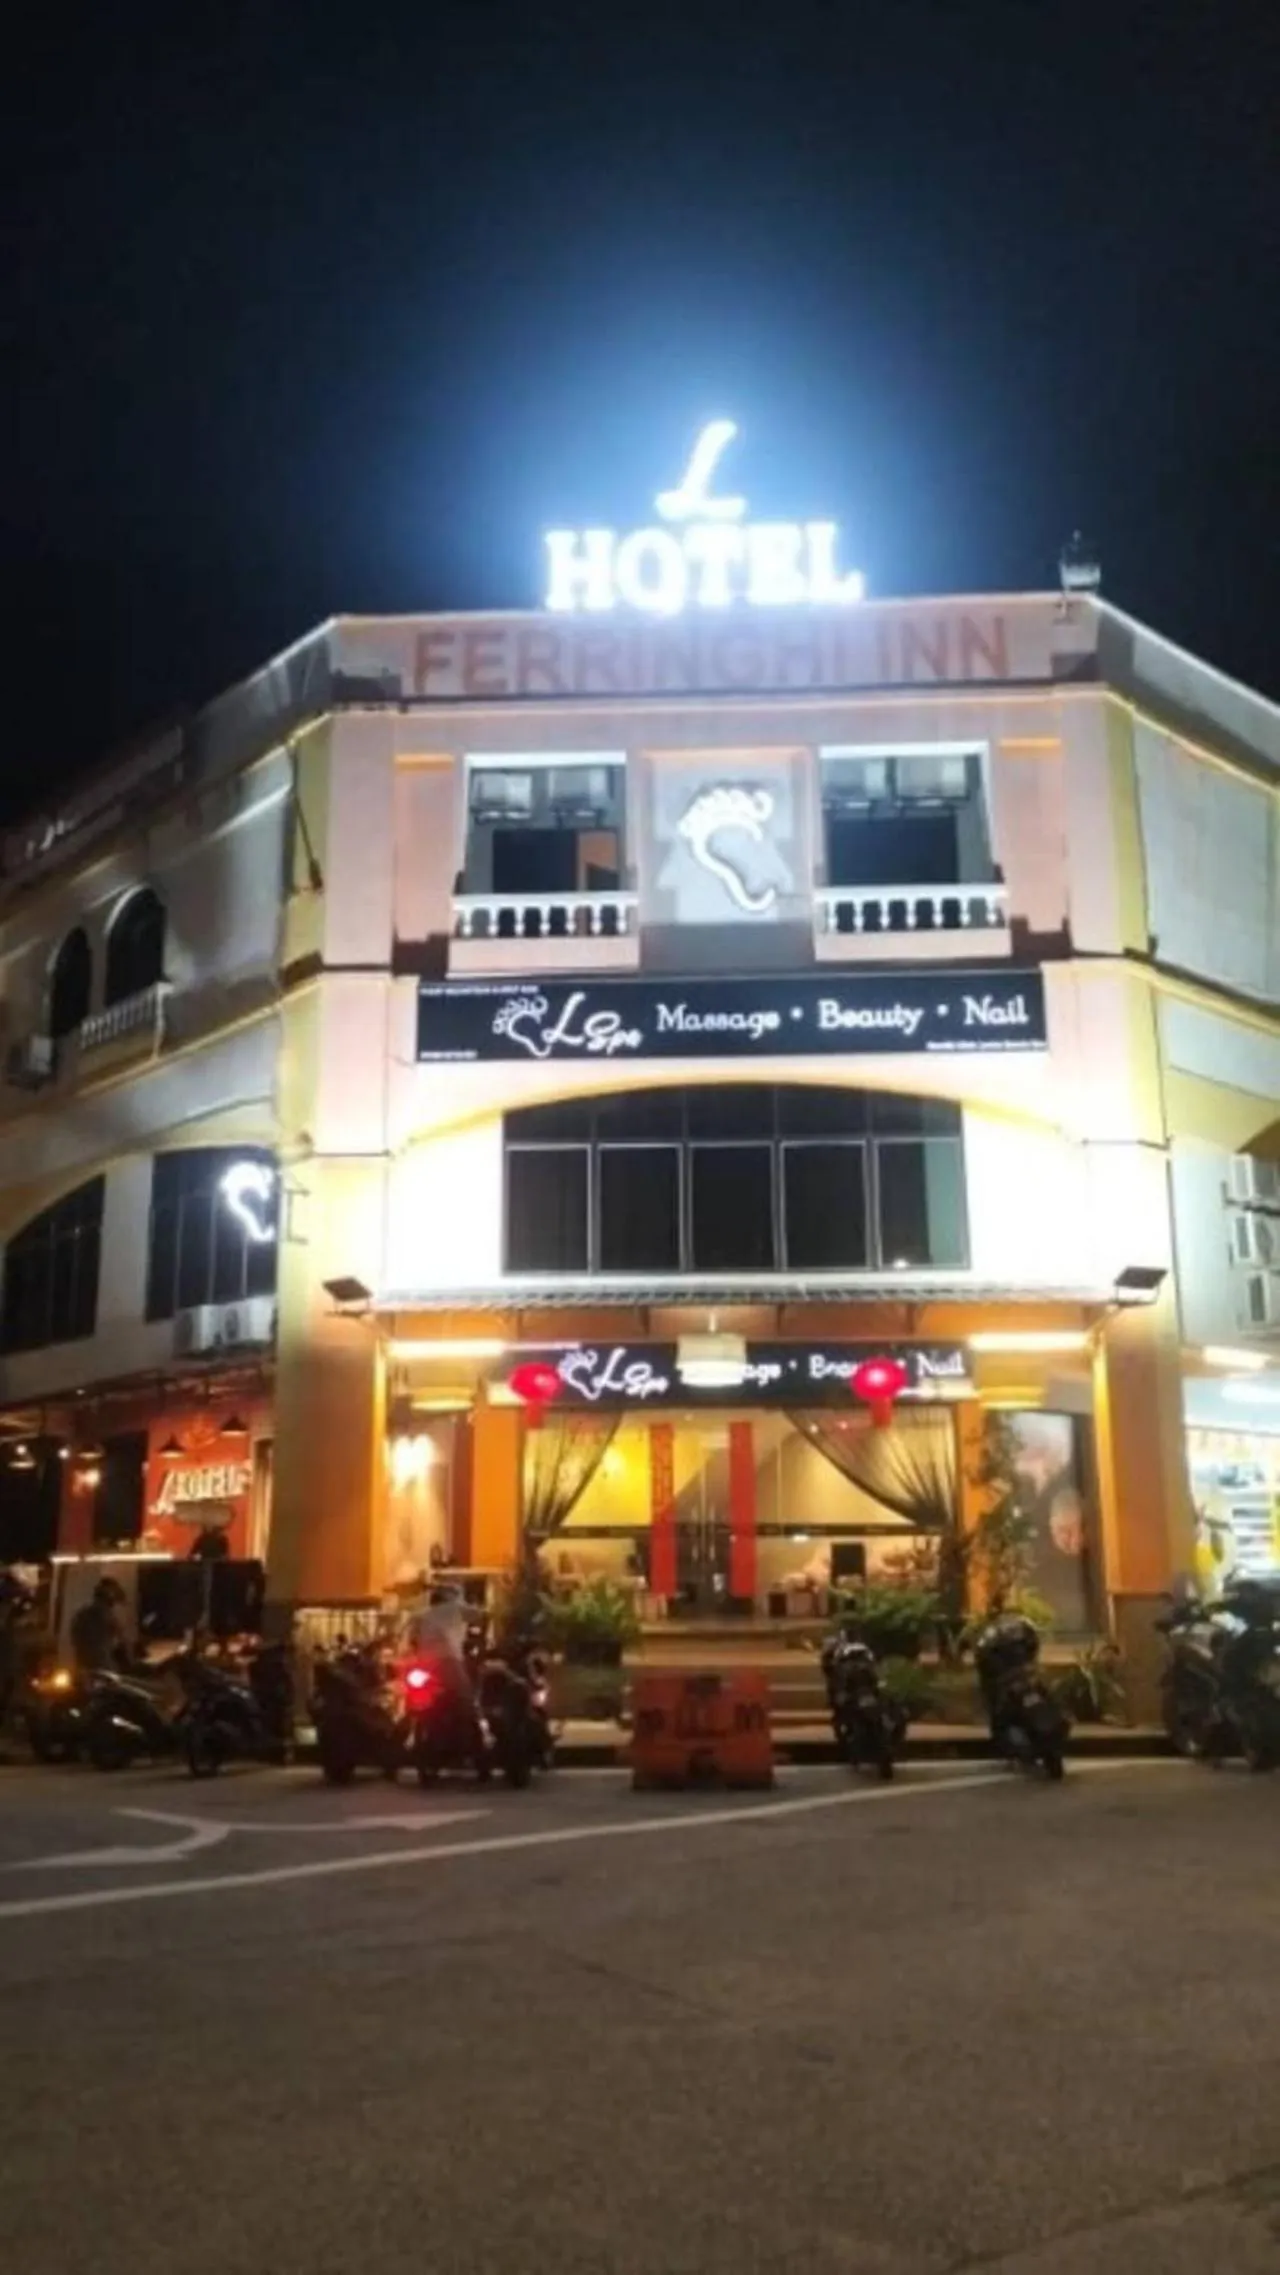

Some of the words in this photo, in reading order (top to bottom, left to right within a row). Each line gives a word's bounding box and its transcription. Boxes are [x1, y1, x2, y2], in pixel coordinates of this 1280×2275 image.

[655, 420, 746, 518] L
[545, 522, 864, 613] HOTEL
[412, 624, 835, 696] FERRINGHI
[878, 617, 1011, 681] INN
[656, 1003, 780, 1039] Massage
[818, 999, 924, 1035] Beauty
[963, 994, 1029, 1026] Nail
